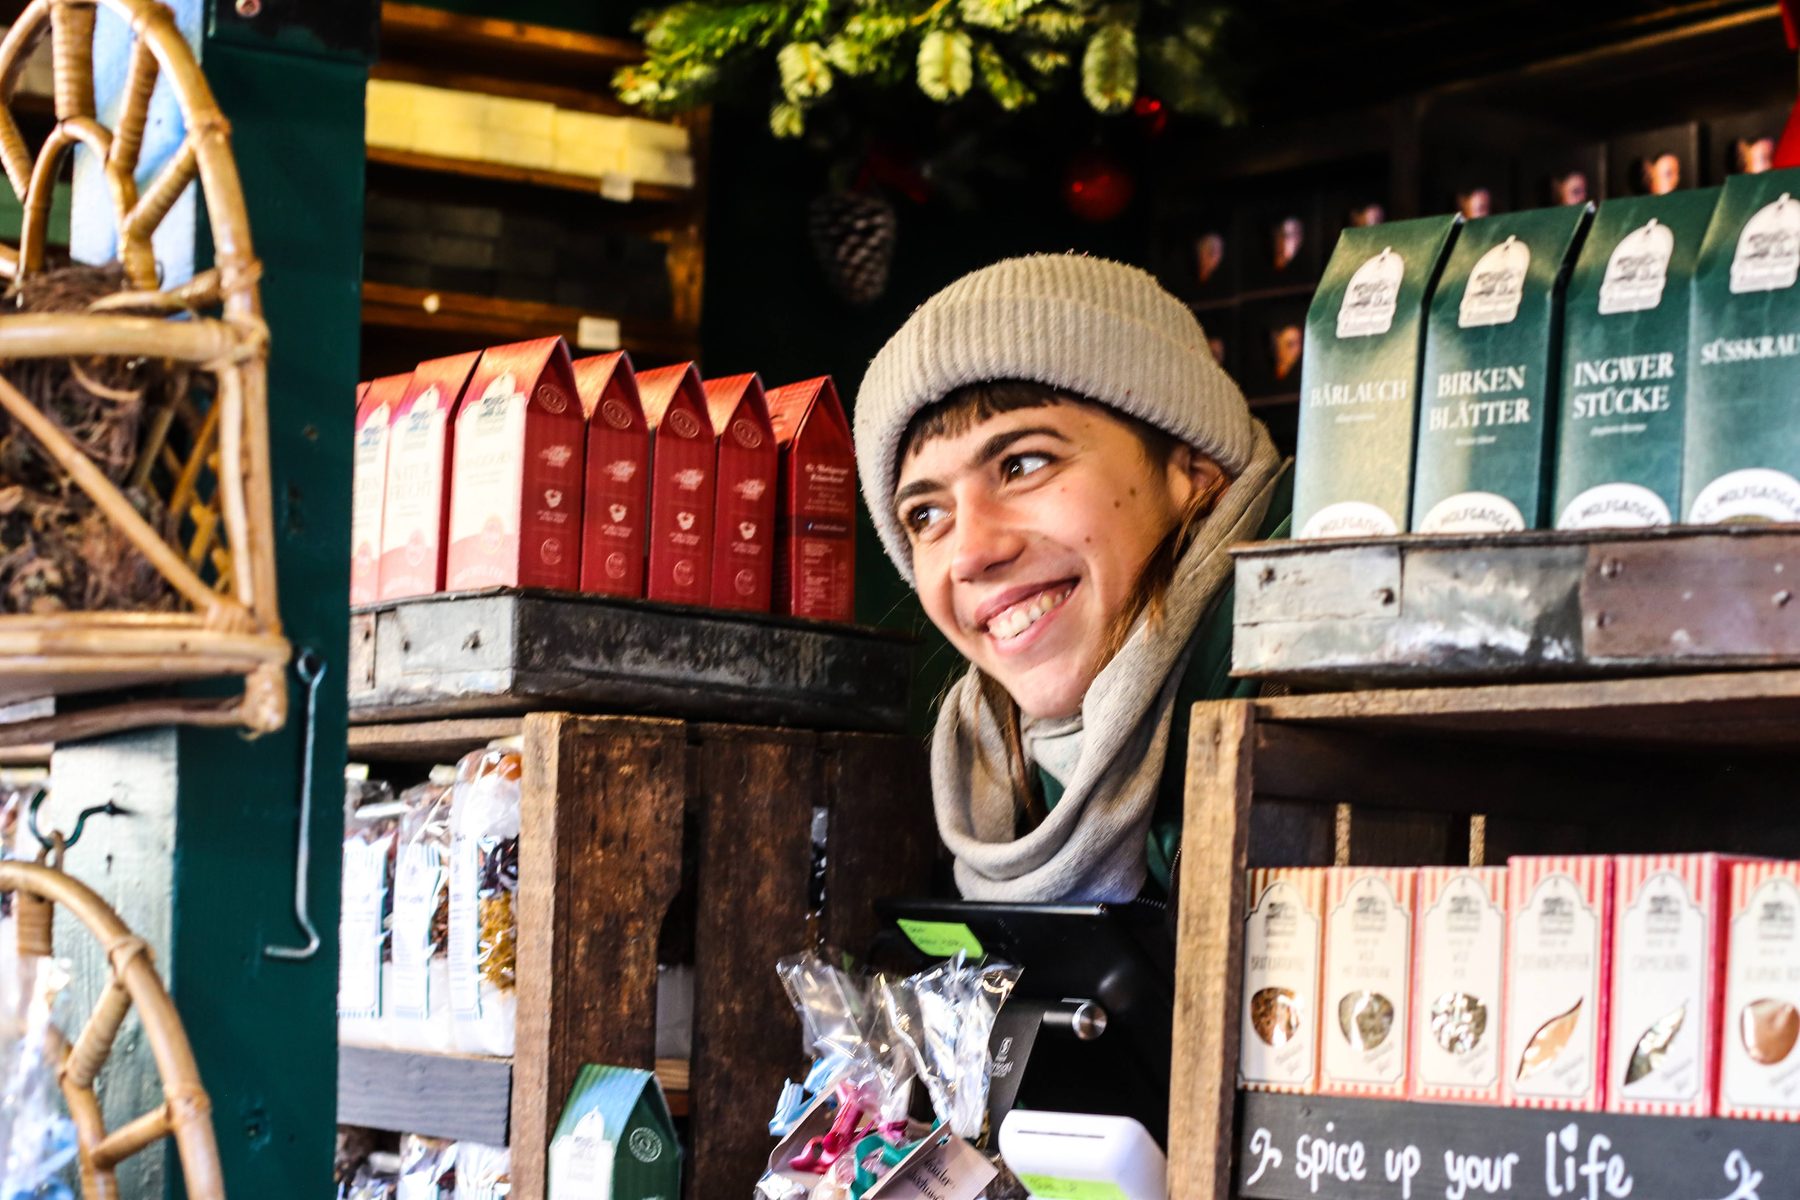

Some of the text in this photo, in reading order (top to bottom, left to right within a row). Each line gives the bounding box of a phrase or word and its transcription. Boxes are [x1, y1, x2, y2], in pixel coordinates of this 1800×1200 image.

[1437, 364, 1527, 398] BIRKEN
[1573, 352, 1674, 387] INGWER
[1309, 379, 1409, 408] BÄRLAUCH
[1572, 385, 1671, 419] STÜCKE
[1429, 397, 1531, 431] BLÄTTER
[1296, 1121, 1633, 1200] spice up your life
